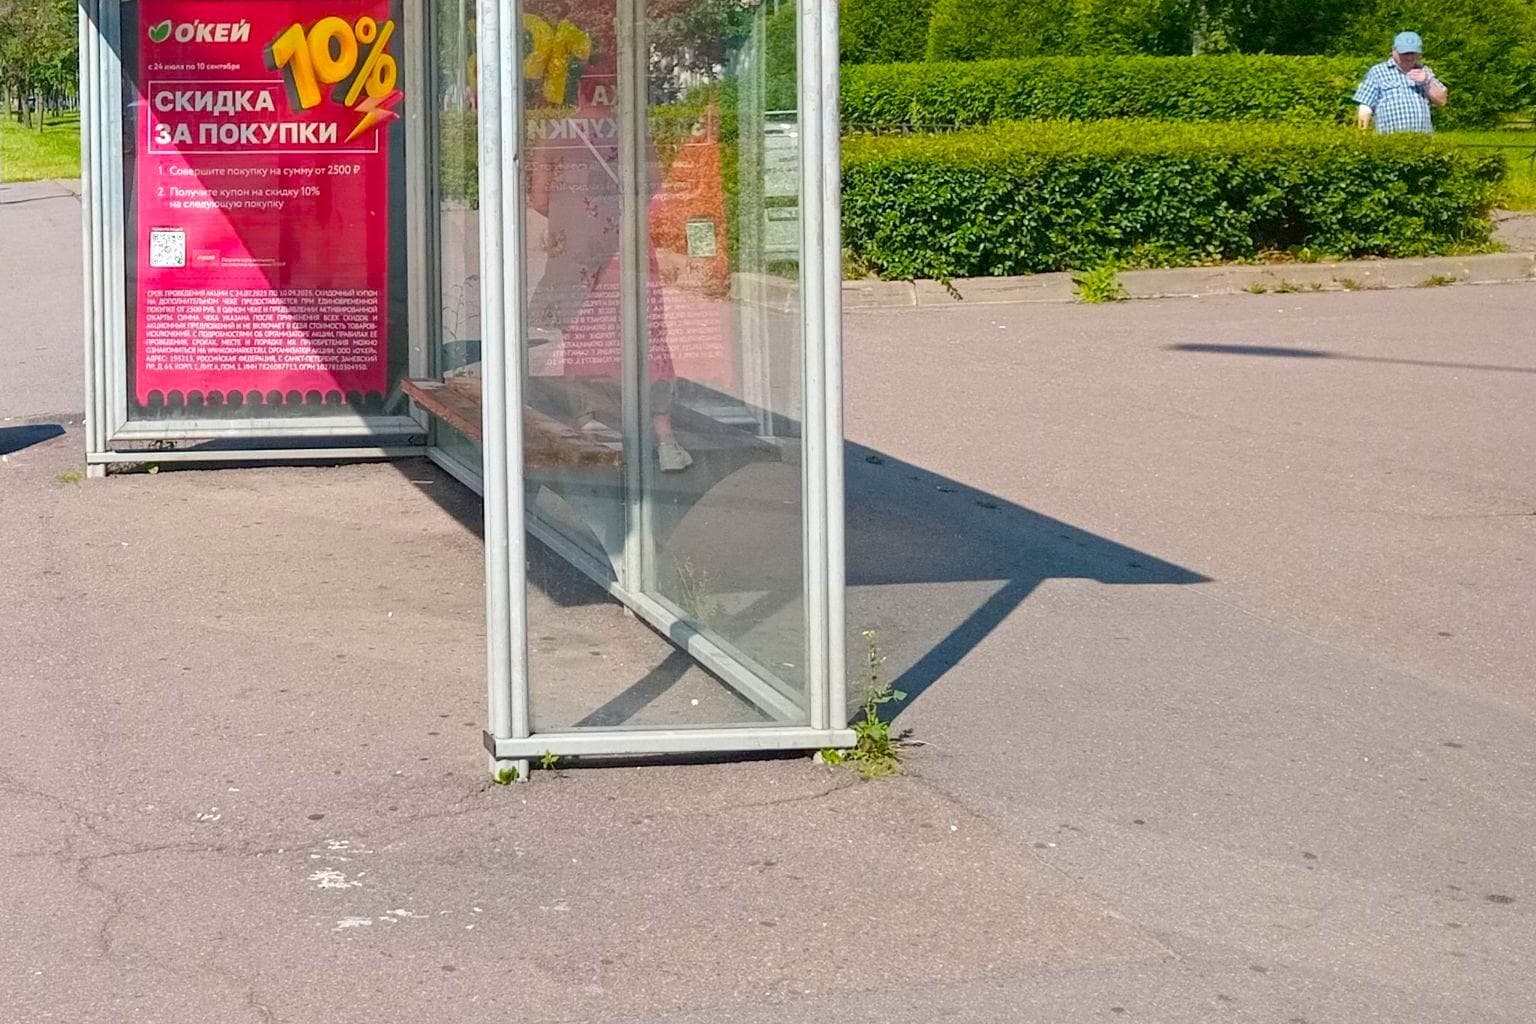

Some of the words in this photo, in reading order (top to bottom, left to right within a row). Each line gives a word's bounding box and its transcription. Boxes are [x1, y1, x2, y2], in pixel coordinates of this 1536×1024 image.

[175, 19, 251, 43] О'КЕЙ
[207, 63, 240, 71] сентября
[272, 16, 397, 109] 10%
[155, 90, 275, 116] СКИДКА
[155, 123, 192, 144] ЗА
[199, 122, 338, 144] ПОКУПКИ
[169, 166, 226, 176] Совершите
[227, 168, 268, 176] покупку
[284, 168, 314, 176] сумму
[327, 165, 351, 175] 2500
[169, 187, 218, 197] Получите
[220, 189, 250, 197] купон
[265, 189, 299, 198] скидку
[301, 186, 321, 196] 10%
[183, 201, 242, 209] следующую
[244, 201, 284, 210] покупку
